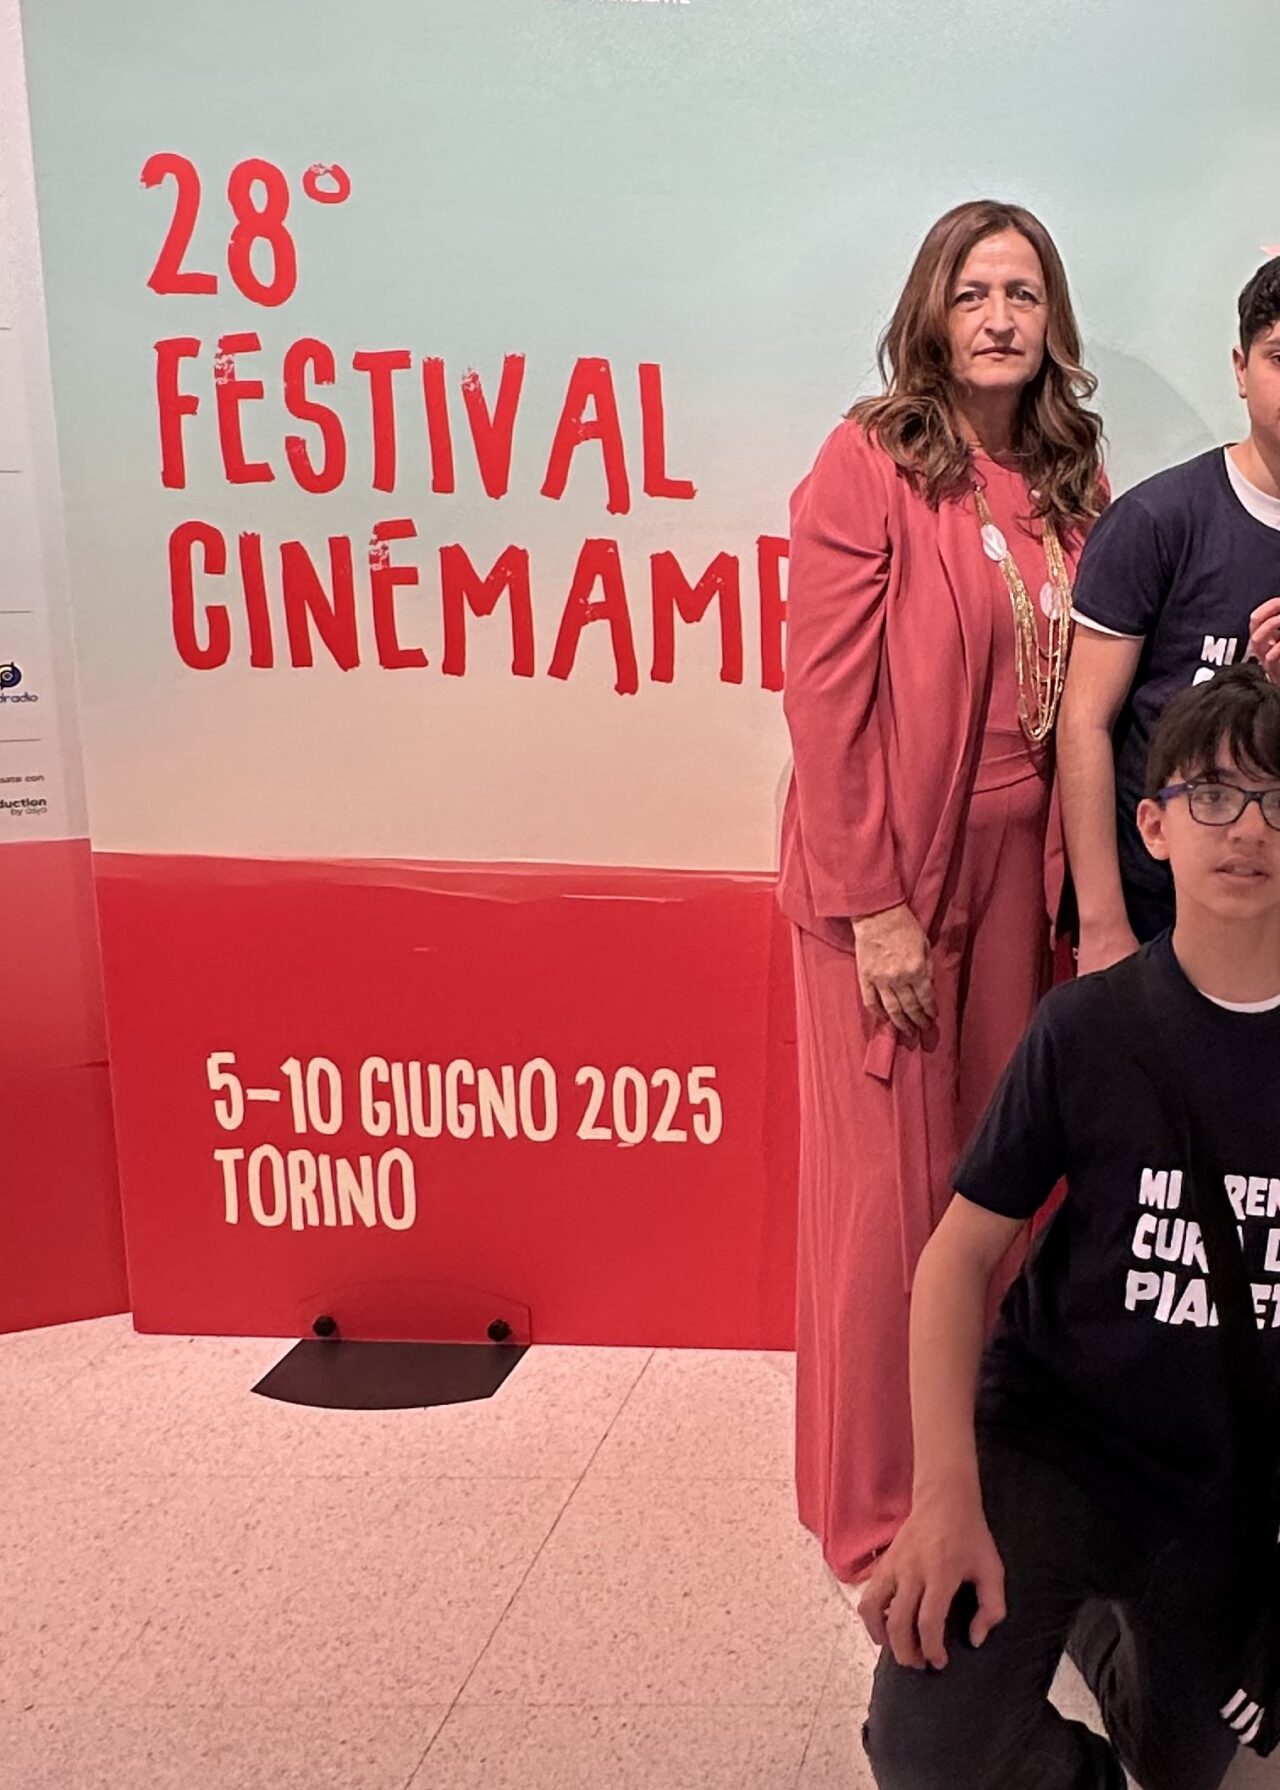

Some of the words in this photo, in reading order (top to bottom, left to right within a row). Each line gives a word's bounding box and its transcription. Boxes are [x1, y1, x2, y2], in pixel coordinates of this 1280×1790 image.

[154, 332, 697, 515] FESTIVAL
[1201, 635, 1238, 667] MI
[359, 1056, 558, 1142] GIUGNO
[574, 1065, 723, 1147] 2025
[213, 1143, 417, 1231] TORINO
[1138, 1168, 1183, 1210] MI
[1132, 1213, 1245, 1274] CUR
